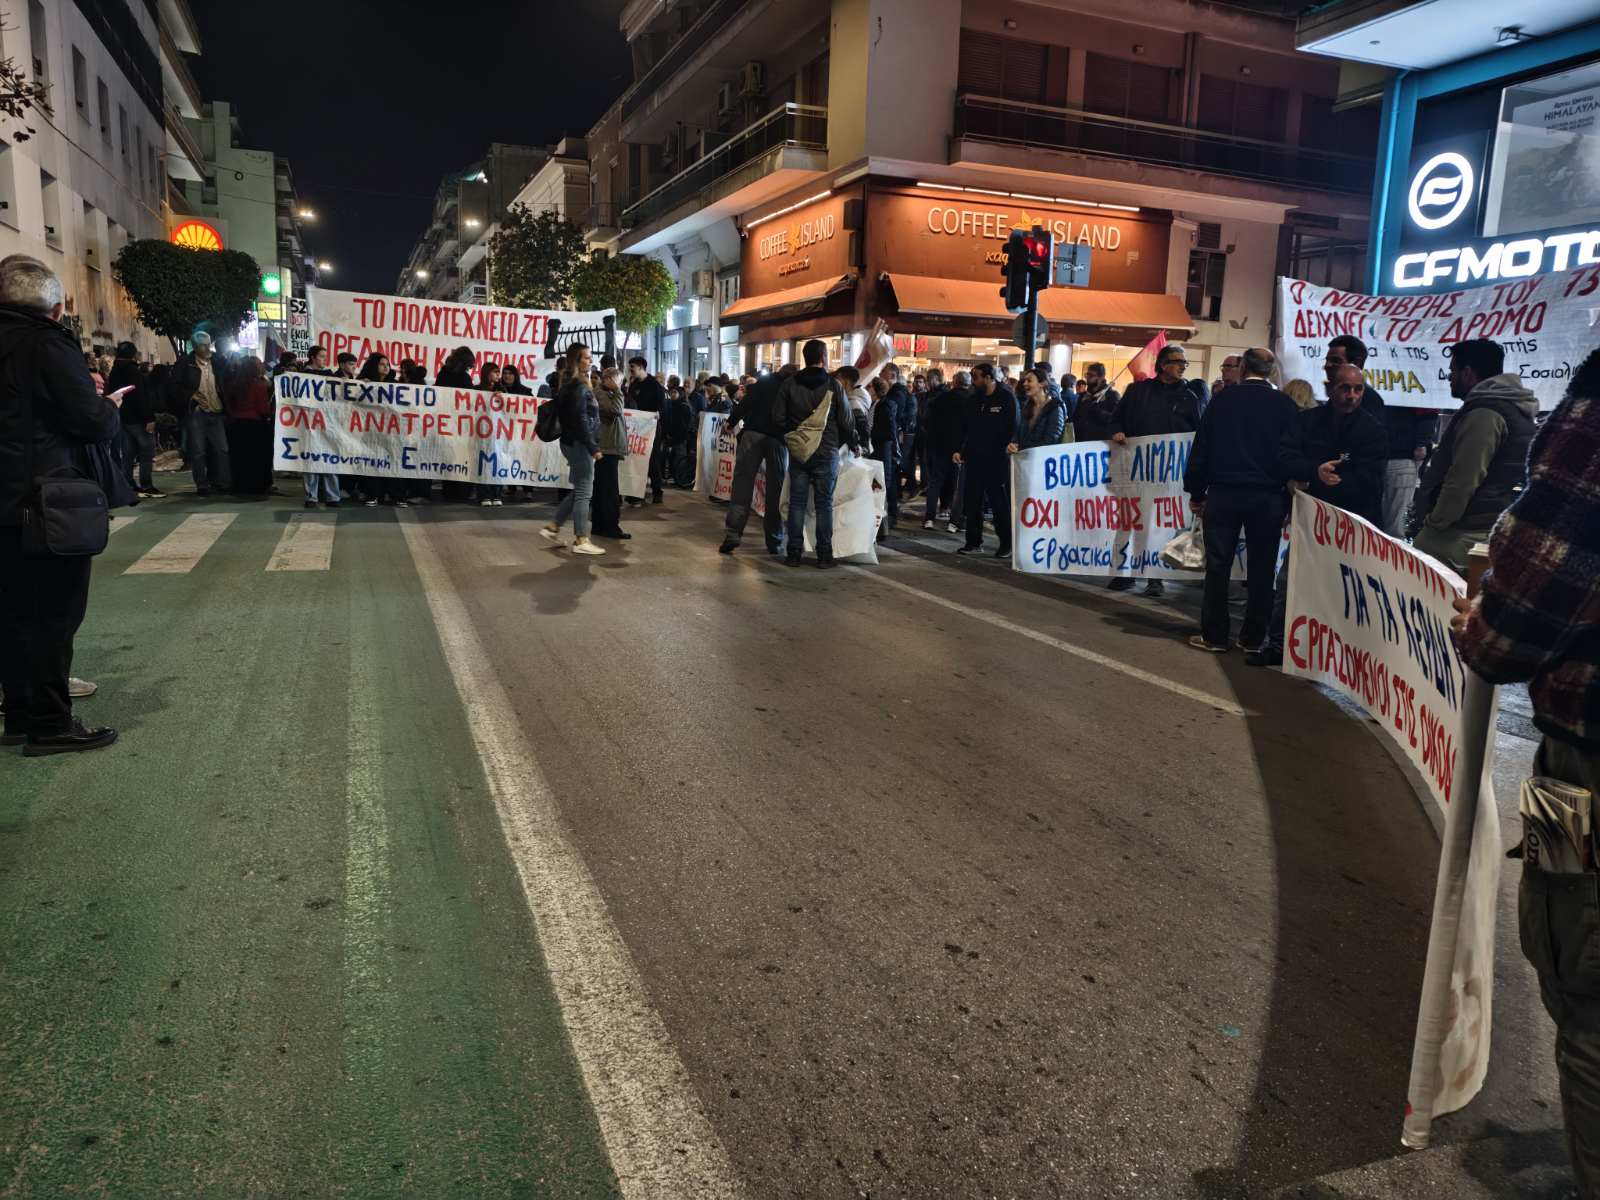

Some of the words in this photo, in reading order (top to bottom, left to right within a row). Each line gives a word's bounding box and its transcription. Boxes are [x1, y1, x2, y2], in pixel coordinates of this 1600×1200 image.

[760, 230, 788, 261] COFFEE
[799, 214, 834, 248] ISLAND
[927, 207, 1009, 239] COFFEE
[1047, 218, 1121, 250] ISLAND
[1320, 288, 1464, 319] ΝΟΕΜΒΡΗΣ
[1491, 276, 1545, 309] ΤΟΥ
[353, 298, 386, 328] ΤΟ
[393, 302, 518, 343] ΠΟΛΥΤΕΧΝΕΙΟ
[519, 314, 549, 345] ΖΕΙ
[1294, 309, 1369, 339] ΔΕΙΧΝΕΙ
[1385, 317, 1423, 342] ΤΟ
[1437, 300, 1547, 344] ΔΡΟΜΟ
[280, 376, 436, 407] ΠΟΛΥΤΕΧΝΕΙΟ
[454, 388, 546, 415] ΜΑΘΗΜ
[1362, 368, 1426, 394] ΝΗΜΑ
[280, 405, 326, 432] ΟΛΑ
[478, 450, 560, 482] Μαθητών
[1045, 450, 1112, 490] ΒΟΛΟΣ
[1130, 440, 1193, 483] ΛΙΜΑΝ
[1020, 498, 1059, 529] ΟΧΙ
[1154, 496, 1186, 529] ΤΩΝ
[1117, 541, 1175, 574] Σωμα
